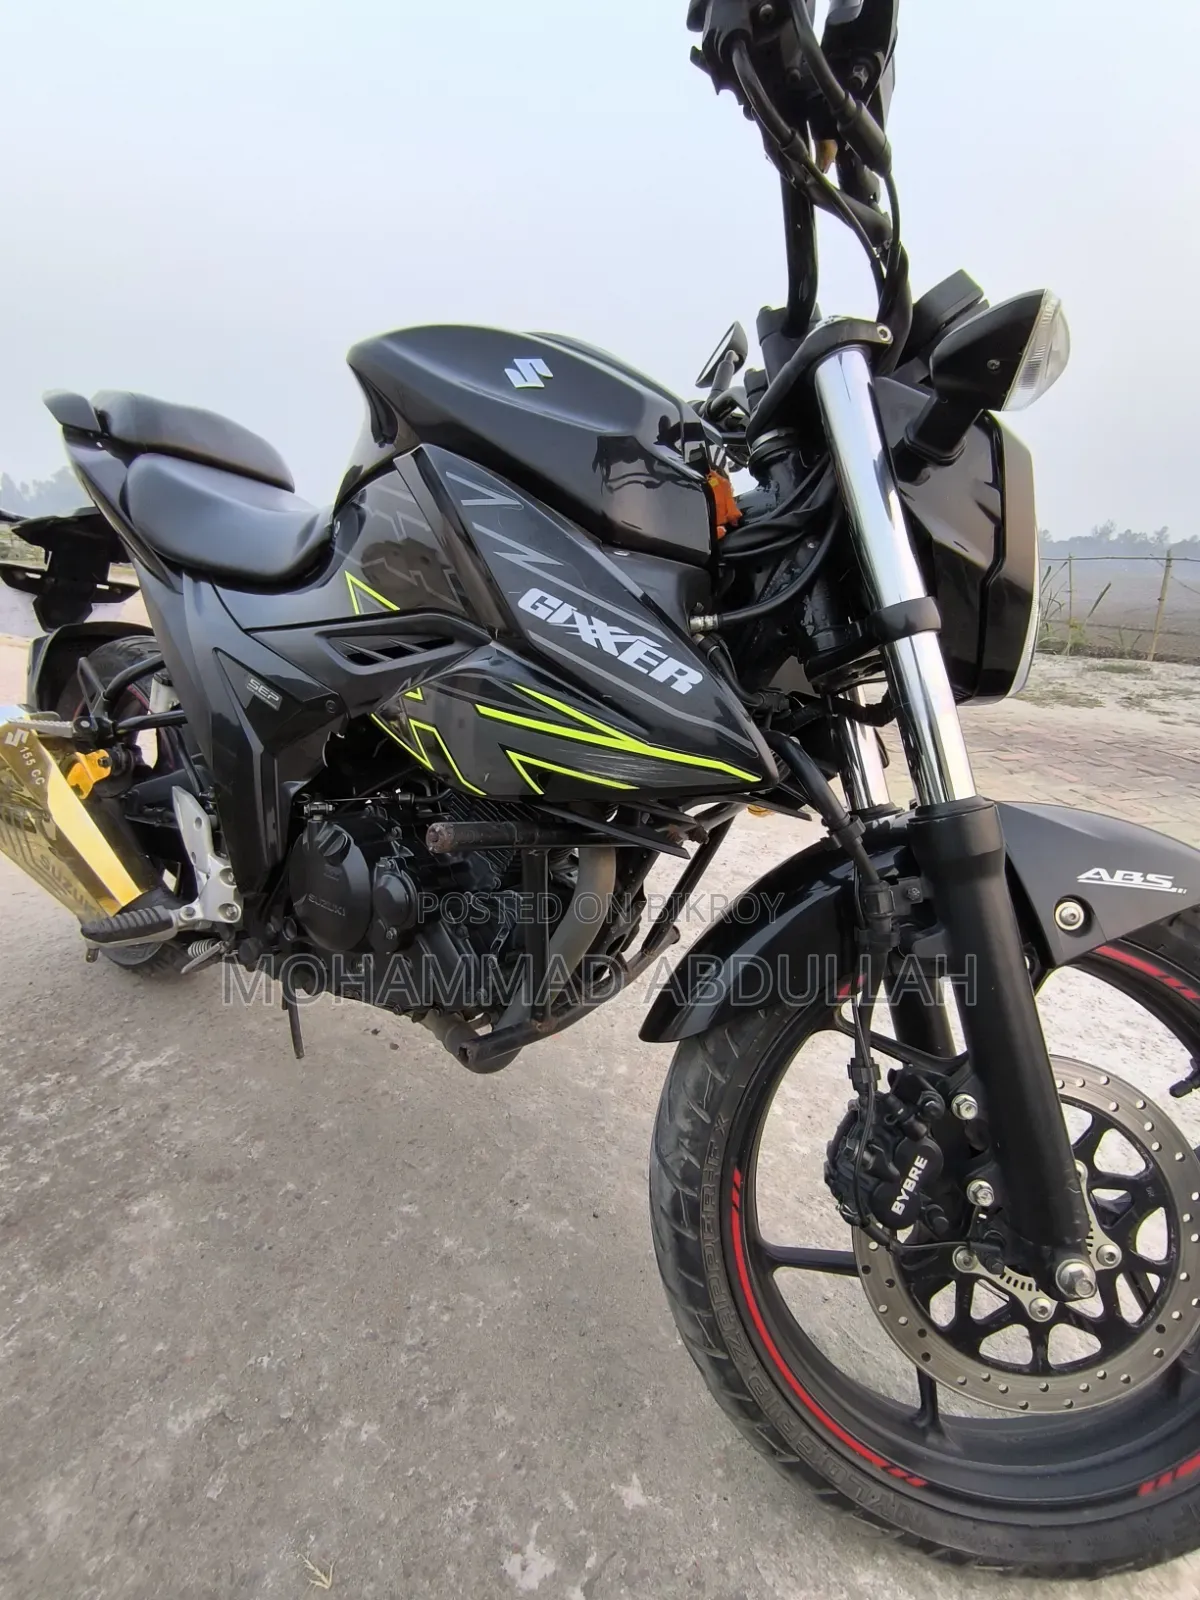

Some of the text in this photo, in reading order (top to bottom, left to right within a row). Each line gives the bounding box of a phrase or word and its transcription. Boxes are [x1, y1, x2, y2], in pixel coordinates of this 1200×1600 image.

[517, 587, 704, 695] GIXXER
[248, 678, 279, 701] SEP
[20, 746, 46, 785] 155 CC
[1076, 867, 1175, 889] ABS
[891, 1155, 928, 1216] BYBRE
